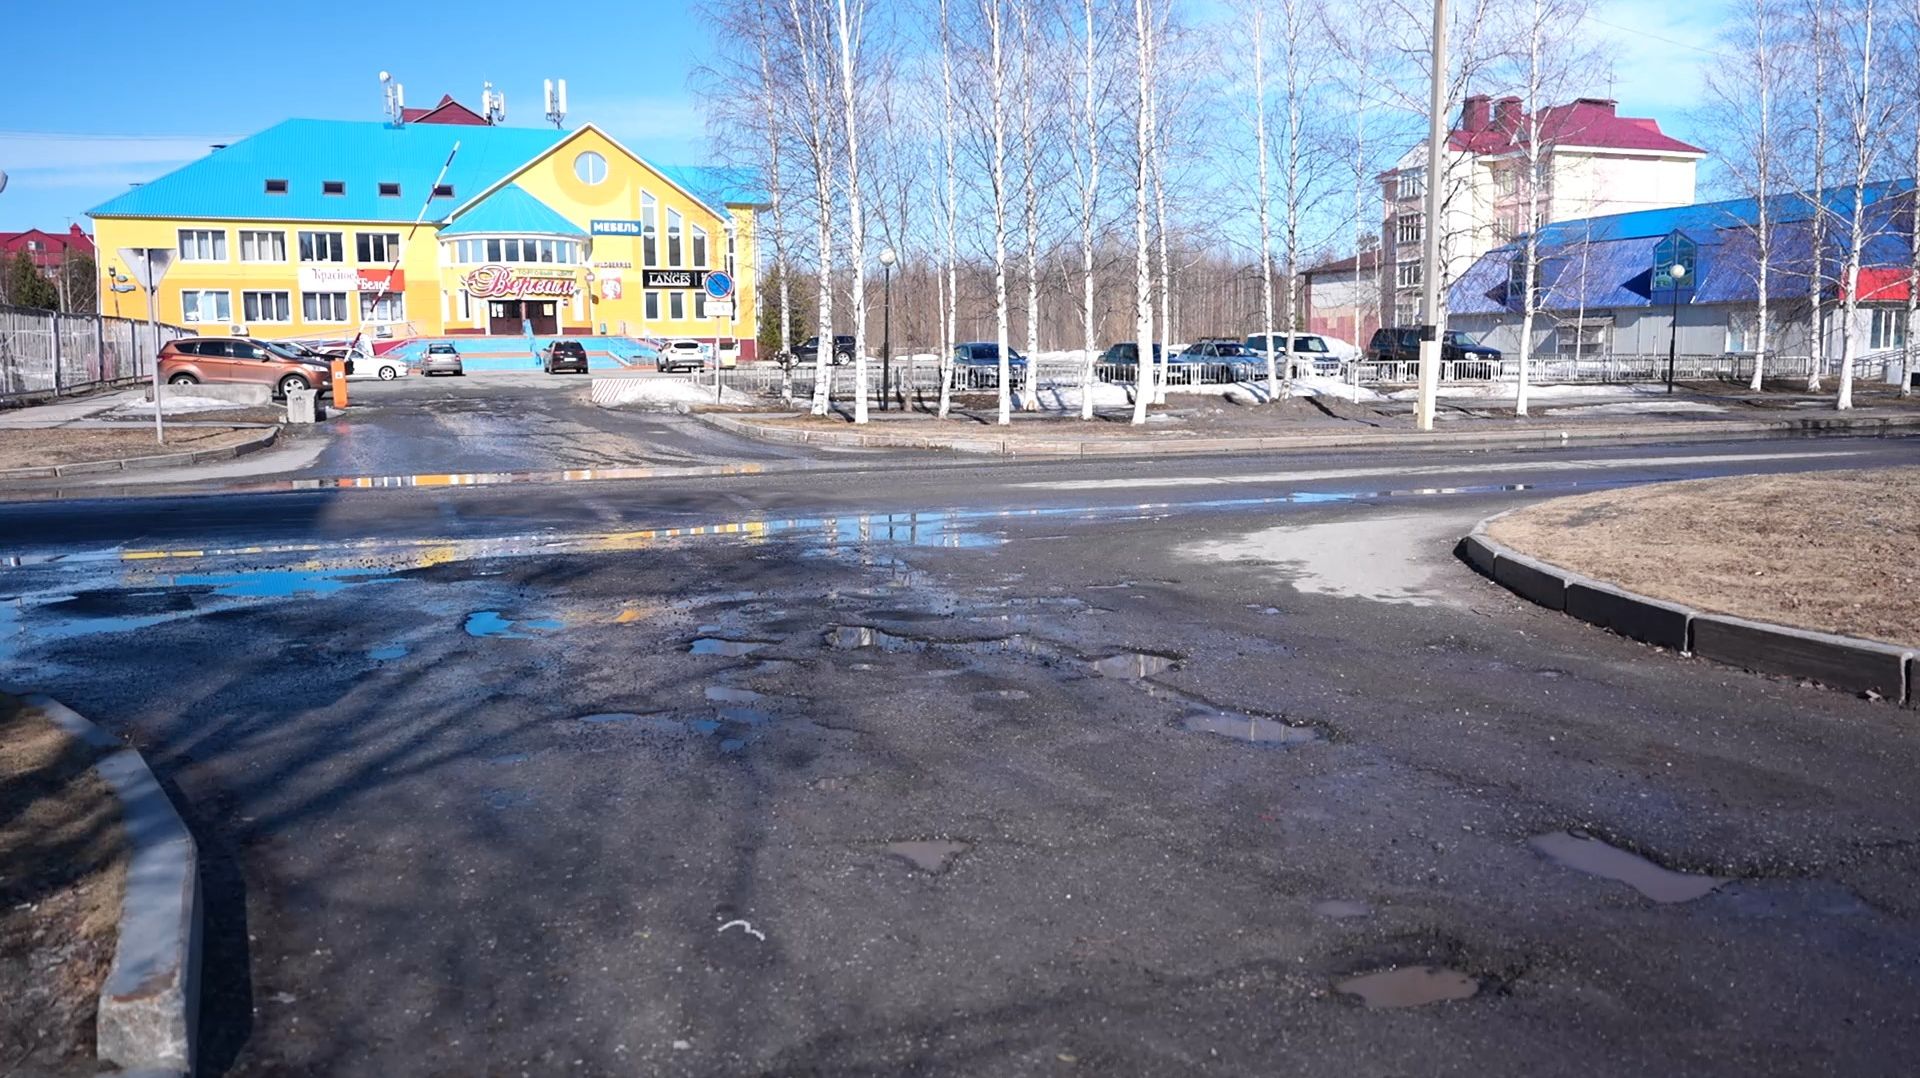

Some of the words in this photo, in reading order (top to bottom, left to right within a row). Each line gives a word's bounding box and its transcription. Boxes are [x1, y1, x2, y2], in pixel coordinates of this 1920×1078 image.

[593, 222, 640, 233] МЕБЕЛЬ
[312, 268, 355, 283] Красное
[361, 278, 390, 290] Белое
[648, 274, 691, 286] LANGES
